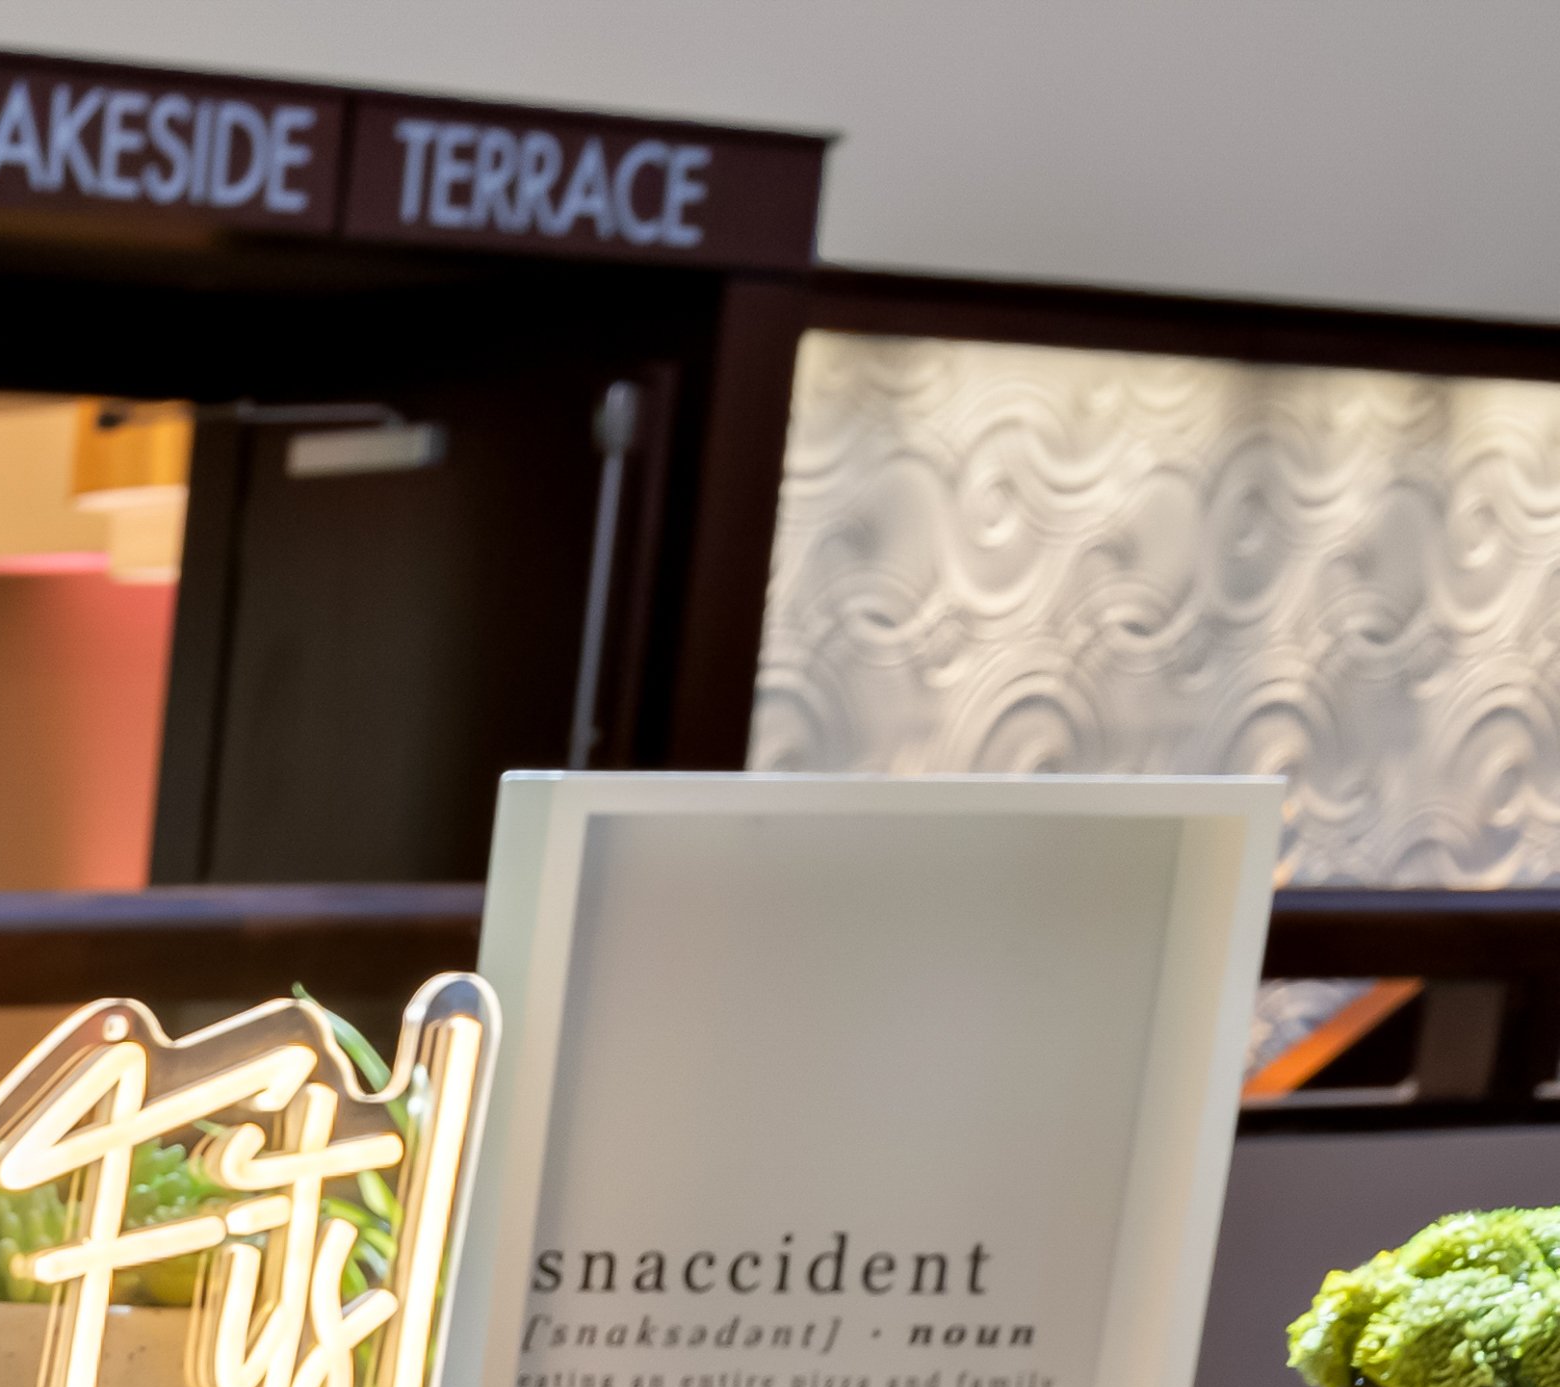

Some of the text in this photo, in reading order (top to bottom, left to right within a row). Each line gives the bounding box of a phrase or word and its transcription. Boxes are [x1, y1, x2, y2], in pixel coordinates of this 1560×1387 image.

[395, 119, 713, 248] TERRACE
[531, 1231, 992, 1296] snaccident
[908, 1322, 1037, 1349] noun
